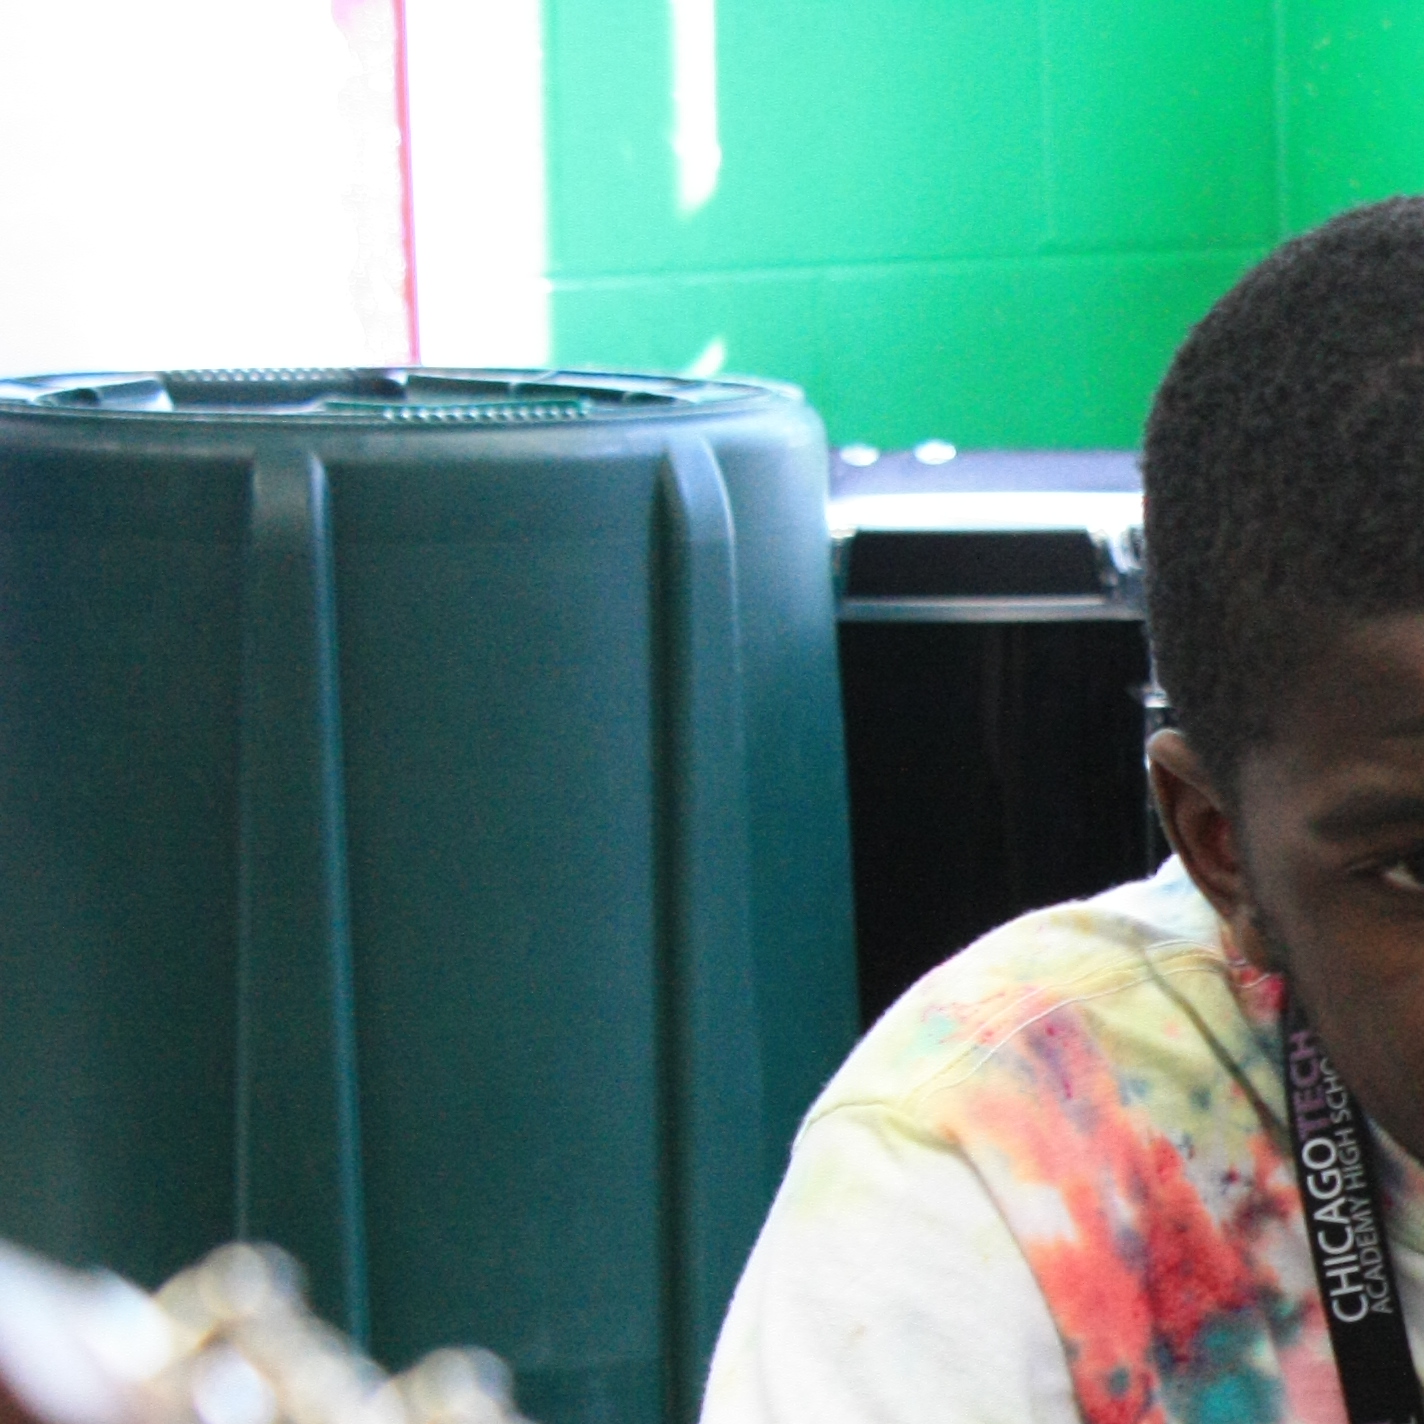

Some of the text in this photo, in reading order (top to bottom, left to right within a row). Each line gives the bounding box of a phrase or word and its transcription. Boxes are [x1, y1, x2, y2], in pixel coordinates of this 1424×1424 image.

[1290, 1031, 1369, 1322] CHICAGO TECH
[1335, 1127, 1367, 1191] HIGH
[1347, 1196, 1393, 1314] ACADEMY
